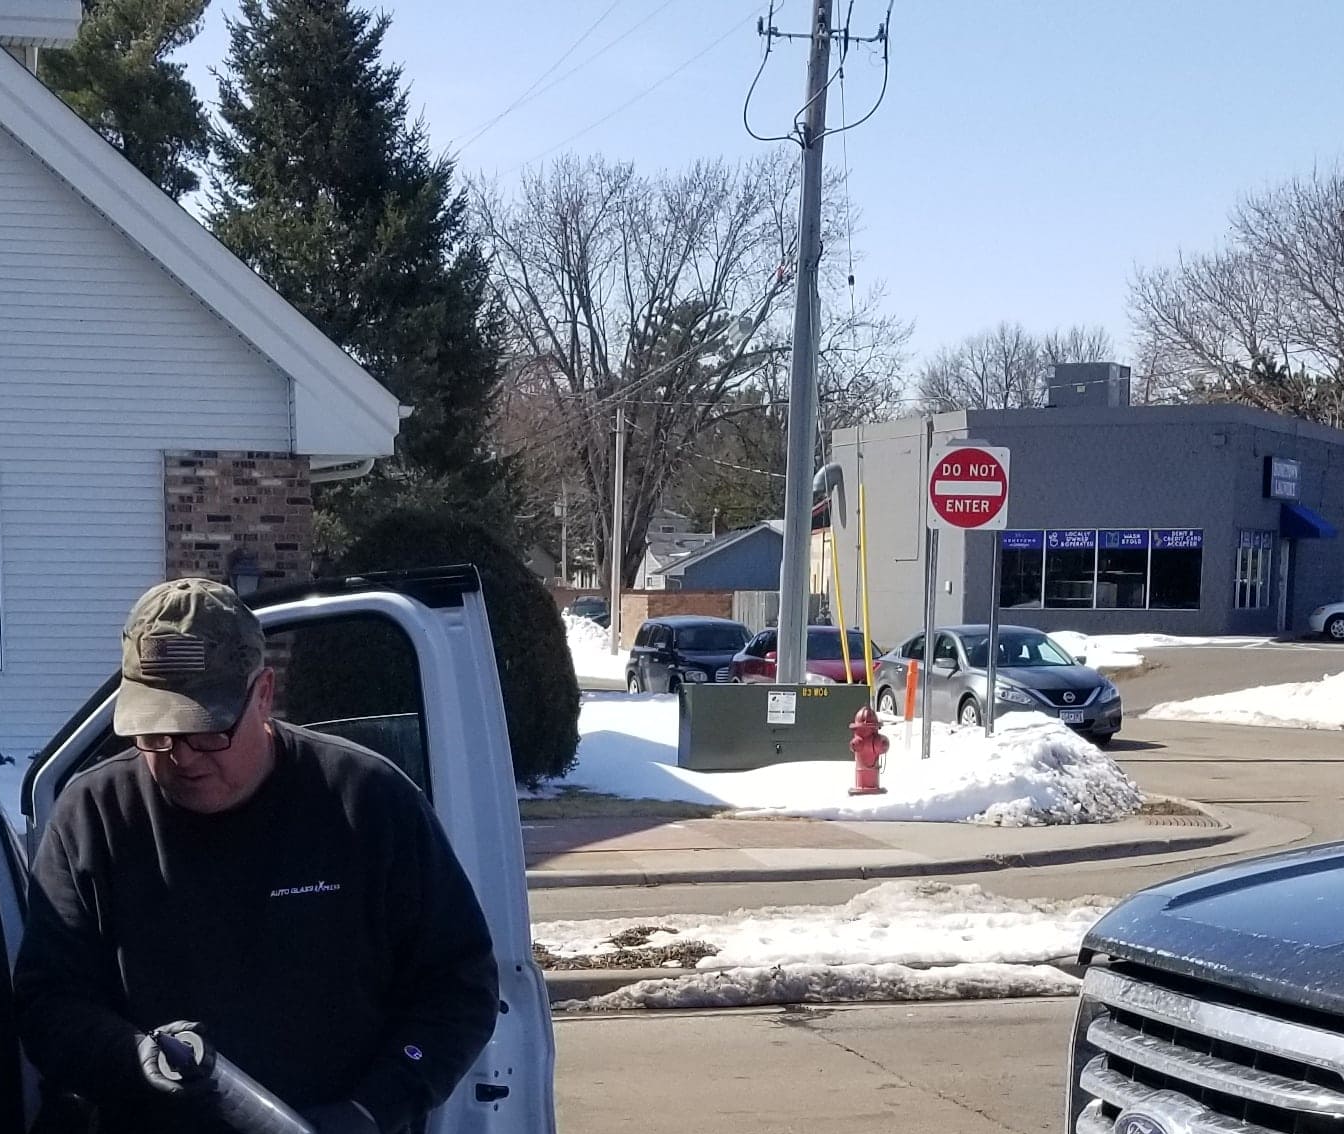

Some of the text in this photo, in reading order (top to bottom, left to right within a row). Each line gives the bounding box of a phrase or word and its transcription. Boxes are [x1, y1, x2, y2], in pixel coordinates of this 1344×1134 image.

[942, 463, 997, 477] DO NOT
[945, 499, 990, 513] ENTER
